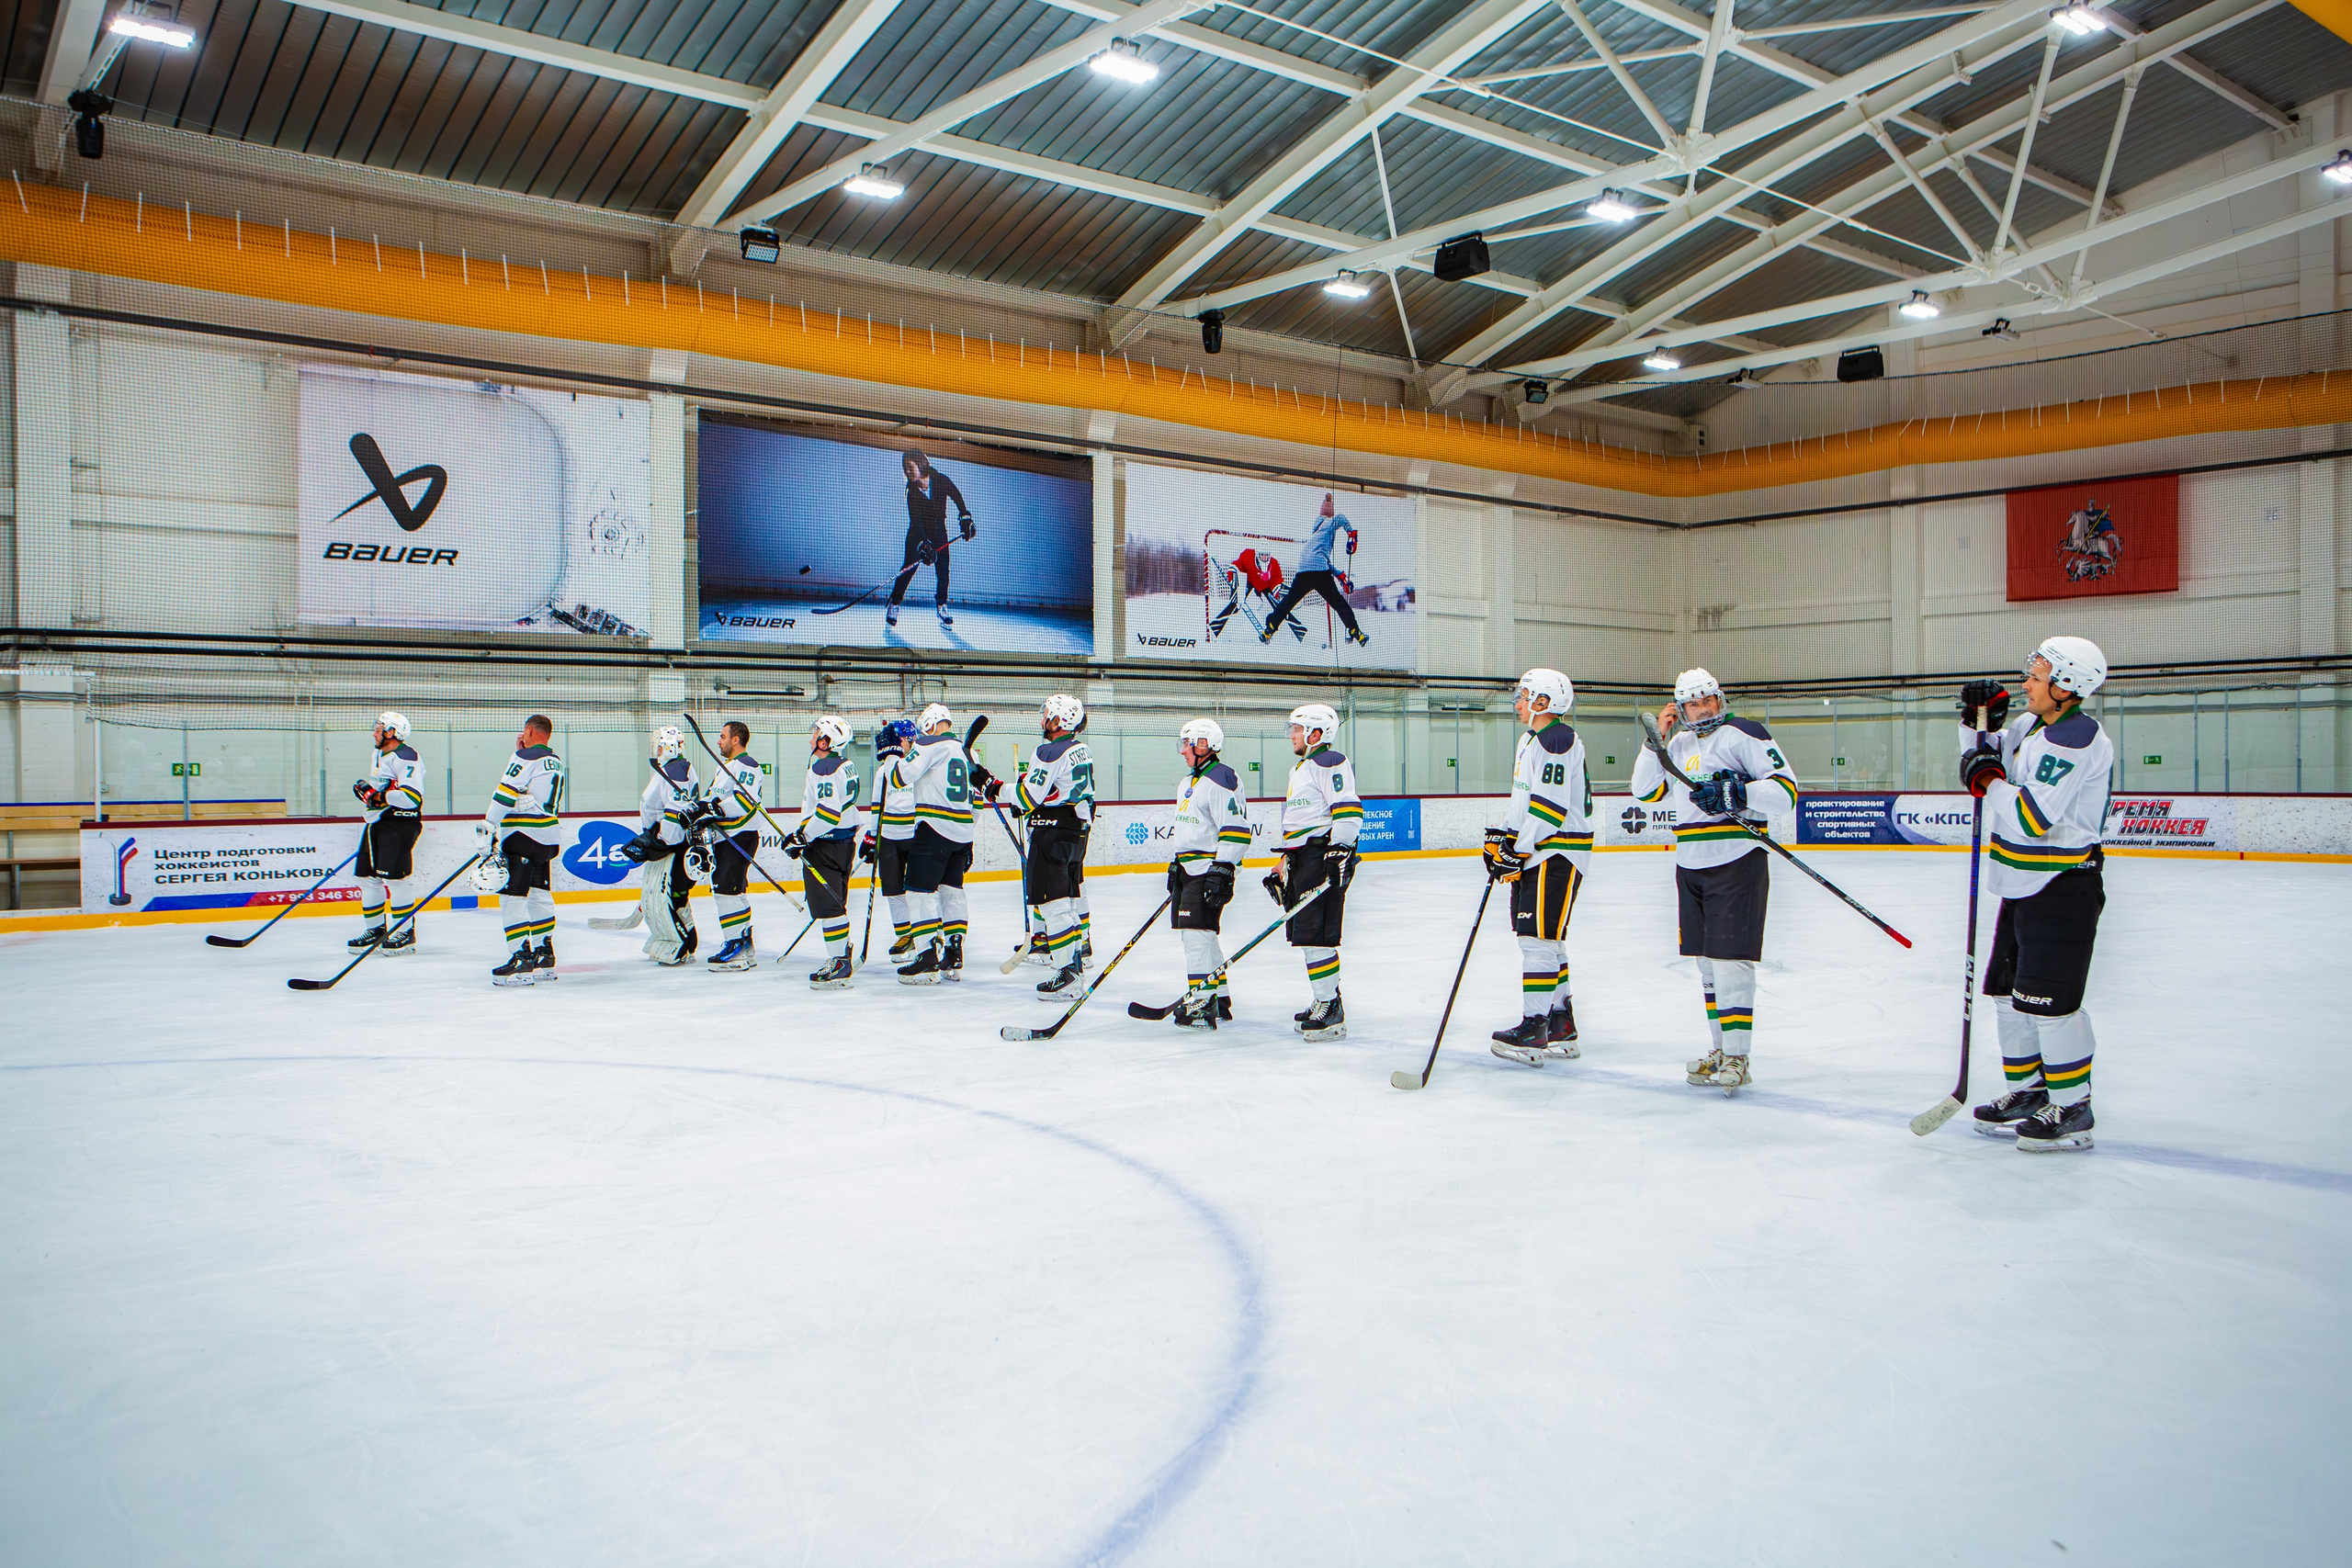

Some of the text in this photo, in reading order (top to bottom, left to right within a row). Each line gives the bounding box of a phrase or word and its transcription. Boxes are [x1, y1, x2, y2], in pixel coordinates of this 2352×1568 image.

[323, 542, 459, 566] BAUER
[729, 616, 796, 628] BAUER
[1148, 637, 1196, 648] BAUER
[1767, 748, 1785, 770] 3
[406, 765, 414, 778] 7
[505, 761, 523, 778] 16
[1542, 762, 1565, 785] 88
[2034, 753, 2075, 787] 87
[738, 771, 755, 786] 83
[1029, 768, 1047, 787] 25
[1332, 773, 1344, 793] 8
[818, 782, 833, 799] 26
[1805, 800, 1885, 812] проектирование
[2106, 800, 2174, 818] РЕМЯ
[1814, 811, 1885, 819] строительство
[1896, 813, 1920, 826] ГК
[1825, 830, 1871, 839] объектов
[2118, 818, 2209, 837] ХОККЕЯ
[1377, 831, 1395, 840] АРЕН
[154, 847, 316, 859] Центр подготовки
[155, 868, 336, 884] СЕРГЕЯ КОНЬКОВА
[318, 891, 343, 900] 346
